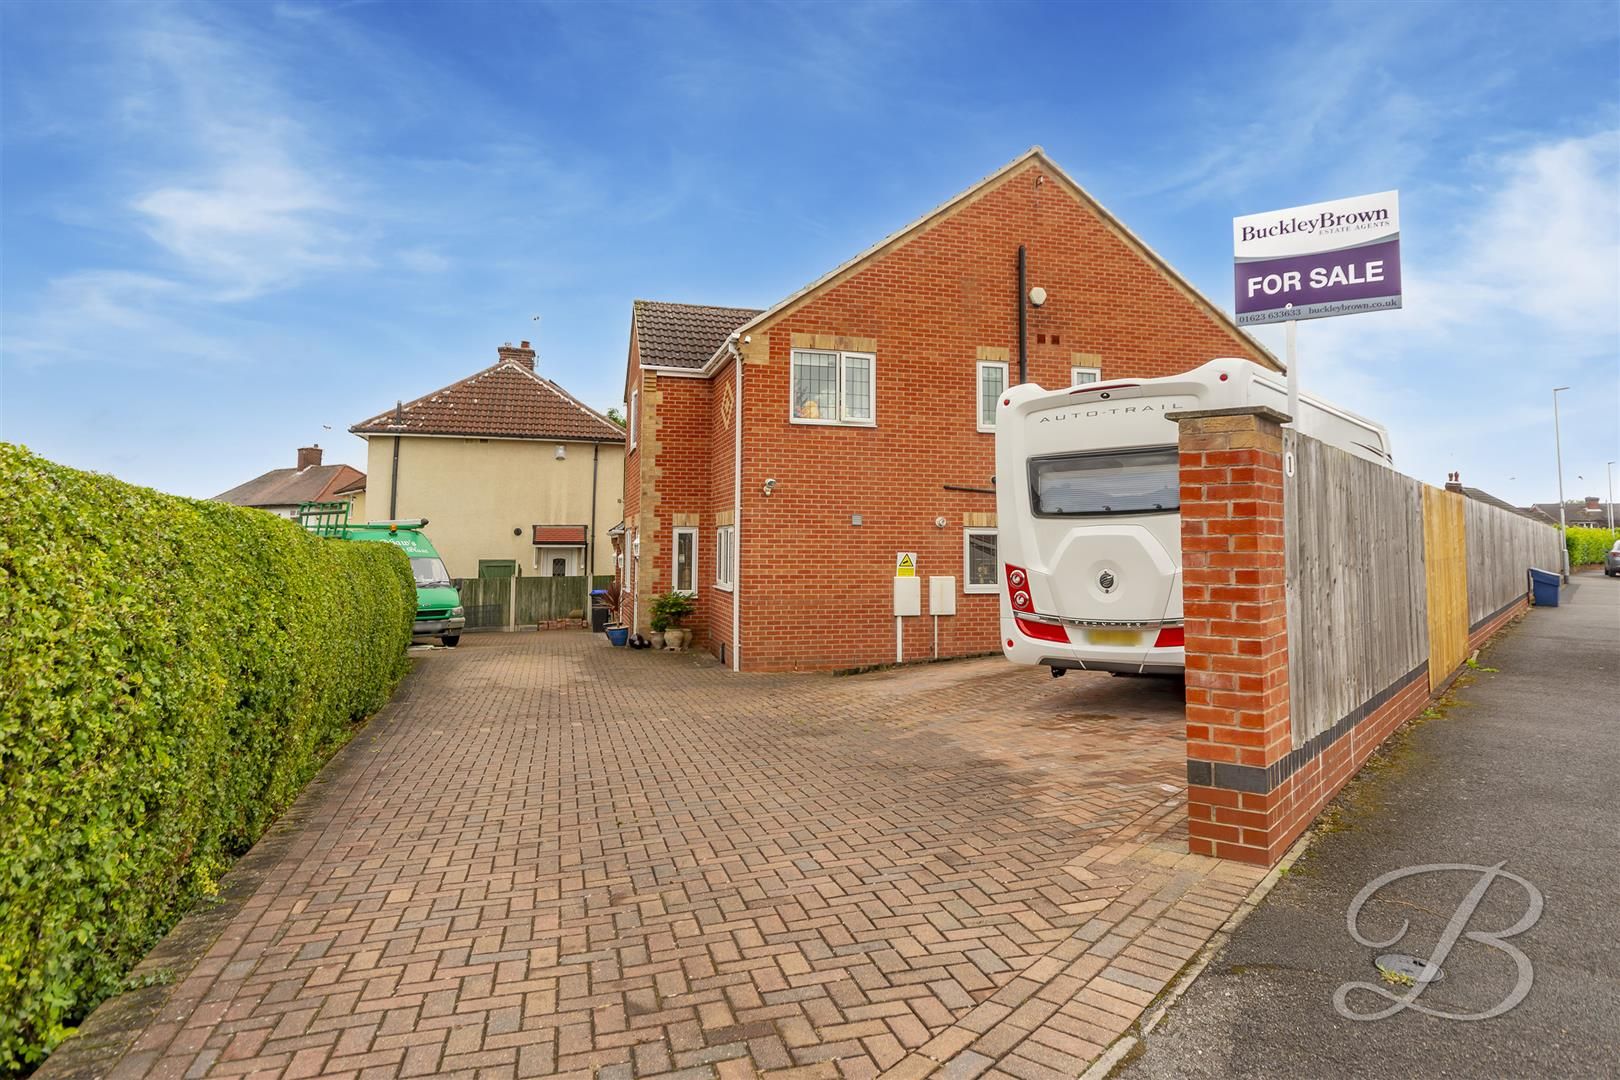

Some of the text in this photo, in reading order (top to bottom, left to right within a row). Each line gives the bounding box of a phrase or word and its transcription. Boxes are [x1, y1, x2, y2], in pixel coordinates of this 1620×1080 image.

[1241, 208, 1389, 242] BuckleyBrown
[1319, 221, 1390, 235] ESTATE AGENTS
[1248, 260, 1384, 298] FOR SALE
[1239, 298, 1398, 323] 01623 633633 buckleybrown.co.uk
[1039, 403, 1184, 424] AUTO-TRAIL
